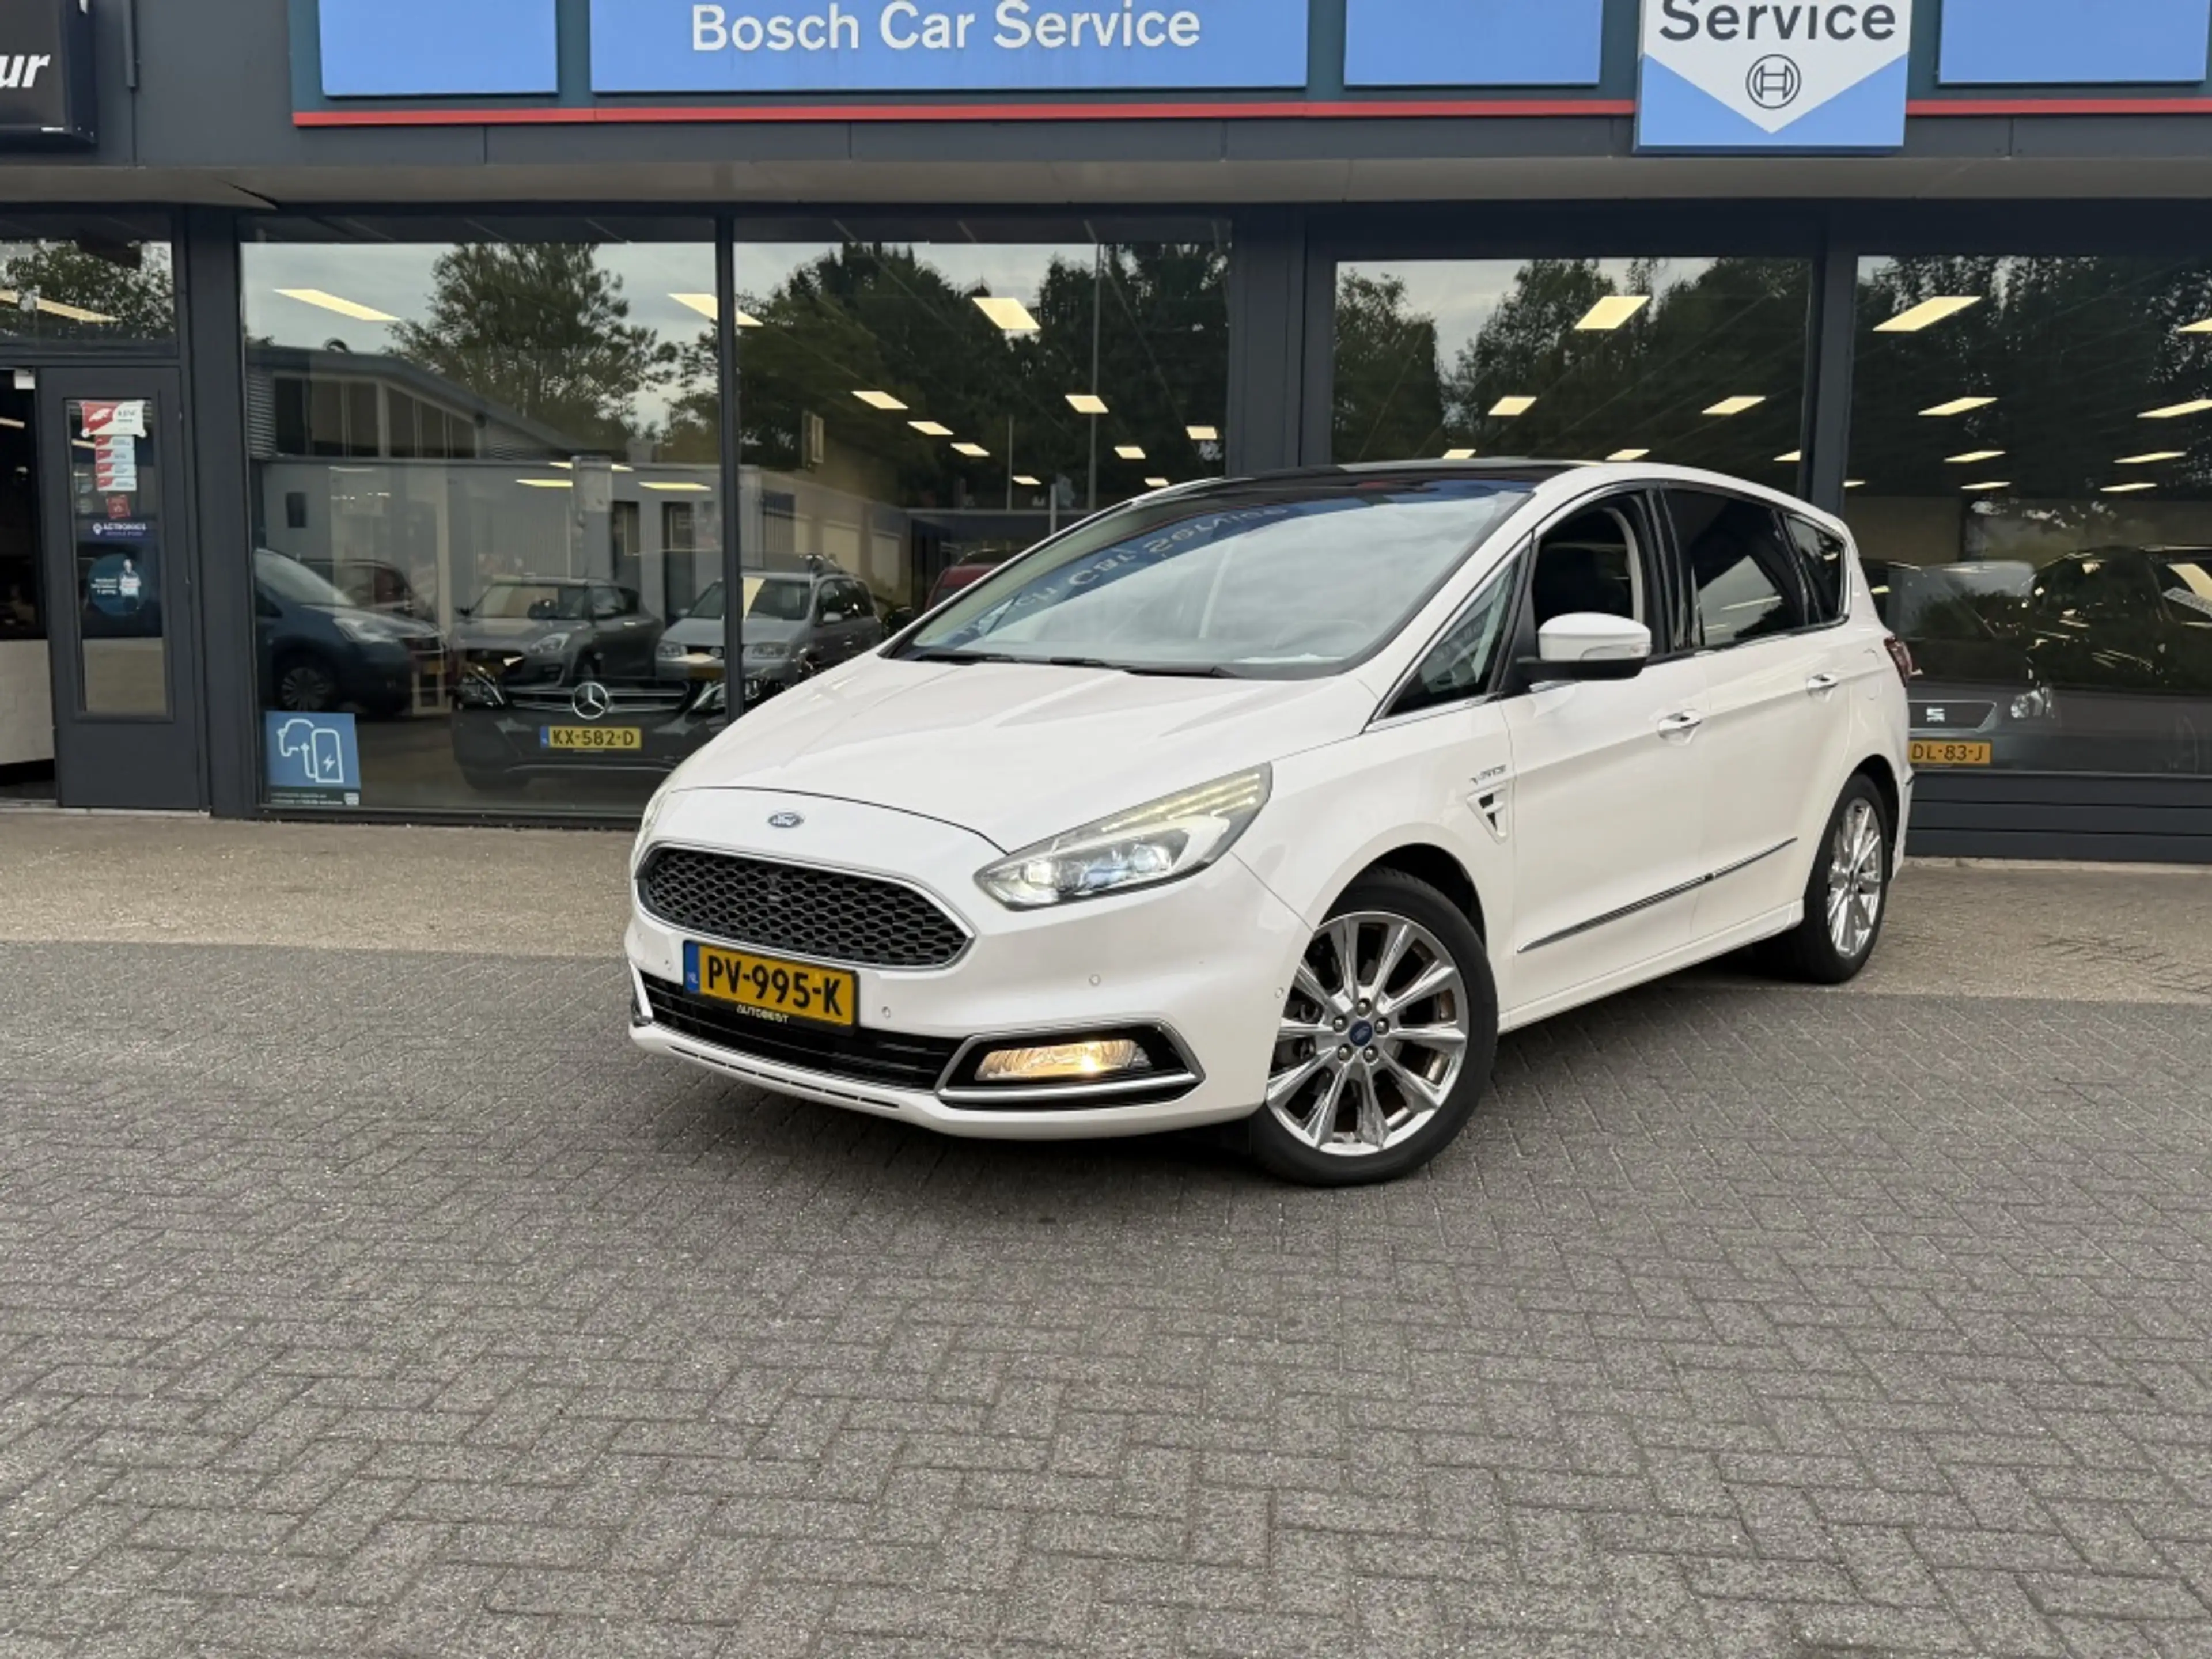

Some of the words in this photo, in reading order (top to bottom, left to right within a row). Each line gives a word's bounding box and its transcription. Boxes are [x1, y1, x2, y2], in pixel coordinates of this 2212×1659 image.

[693, 3, 859, 51] Bosch
[881, 1, 975, 49] Car
[994, 0, 1200, 48] Service
[1659, 0, 1896, 40] Service
[552, 730, 634, 746] KX-582-D
[1911, 743, 1983, 762] DL-83-J
[707, 955, 843, 1017] PV-995-K
